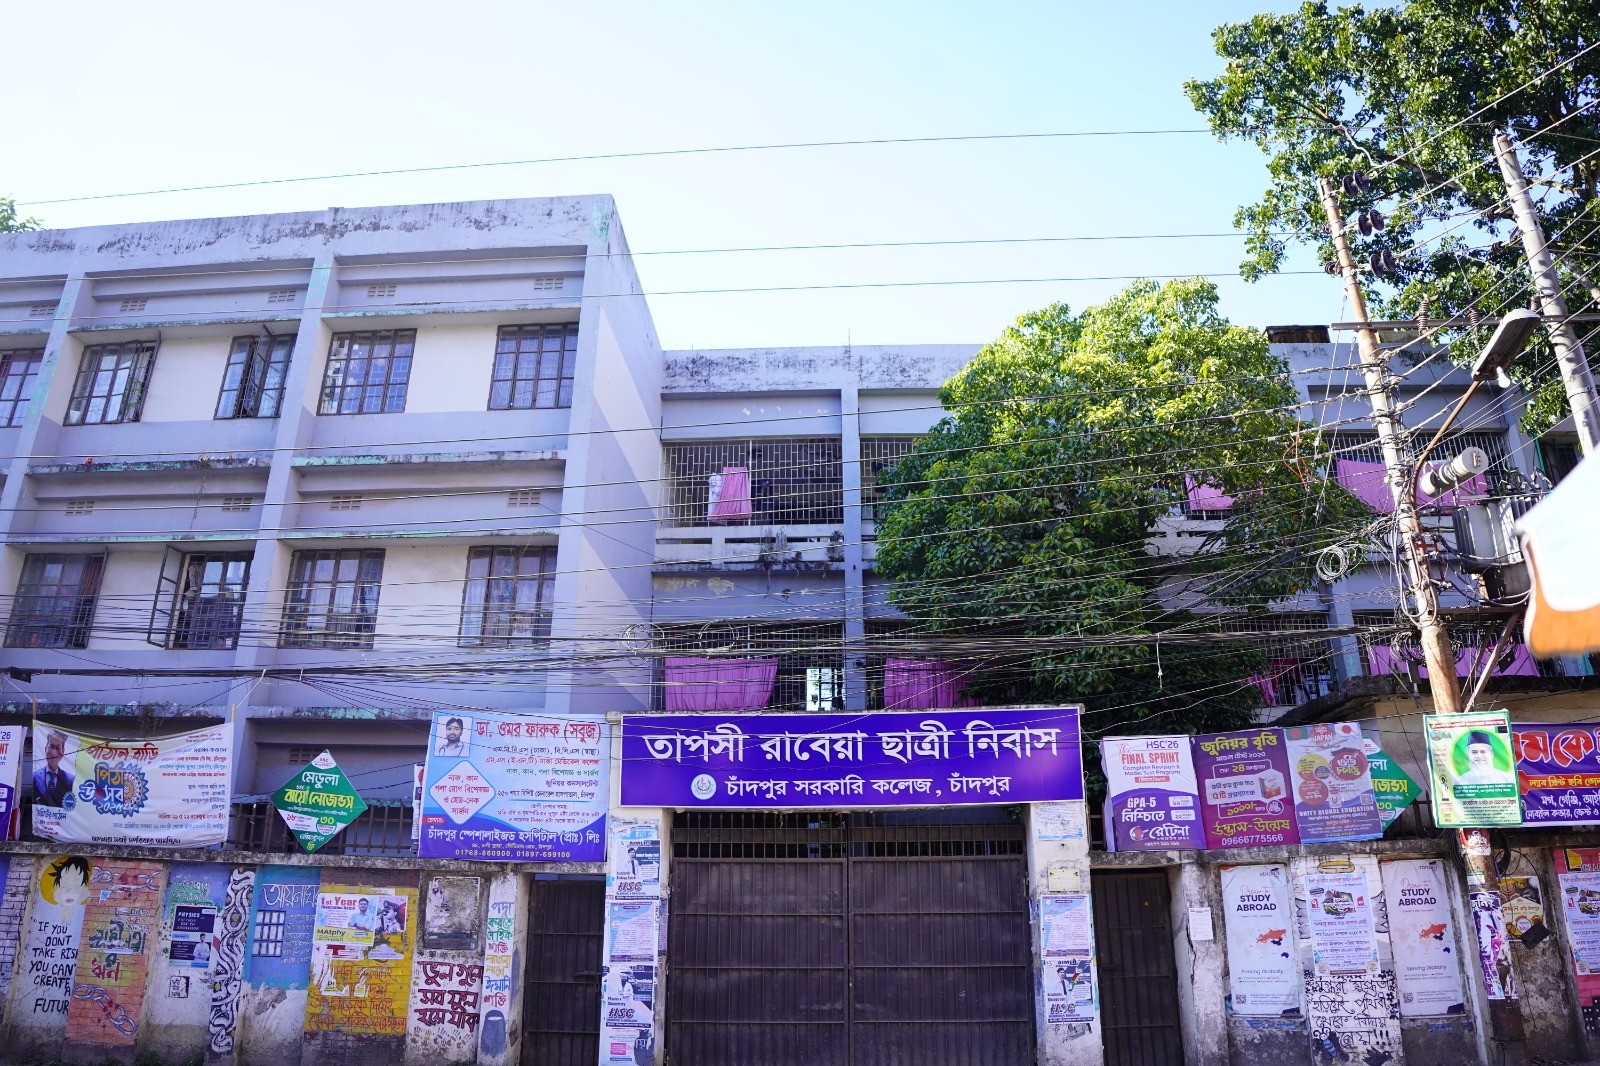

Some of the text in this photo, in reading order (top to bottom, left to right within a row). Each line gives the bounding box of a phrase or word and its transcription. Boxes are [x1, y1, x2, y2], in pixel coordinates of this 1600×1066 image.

[476, 721, 601, 744] ডা. ওমর ফারুক (সবুজ)
[642, 720, 1062, 763] তাপসী রাবেয়া ছাত্রী নিবাস
[1200, 732, 1278, 756] জুনিয়র বৃত্তি
[87, 741, 158, 764] পাঠান বাড়ি
[1122, 752, 1180, 764] FINAL SPRINT
[1232, 764, 1245, 772] ২৪
[302, 771, 340, 789] মেডুলা
[725, 775, 788, 800] চাঁদপুর
[793, 774, 866, 796] সরকারি
[948, 772, 1012, 796] চাঁদপুর
[1529, 779, 1547, 788] ল্যাব
[1568, 775, 1583, 787] ছবি
[1128, 797, 1156, 808] GPA-5
[1541, 794, 1556, 807] মগ,
[1122, 808, 1166, 822] নিশ্চিতে
[1342, 806, 1374, 814] EDUCATION
[1526, 806, 1550, 820] মোবাইল
[428, 826, 600, 845] চাঁদপুর স্পেশালাইজড হসপিটাল (প্রাঃ) লিঃ
[1149, 823, 1190, 840] রেটিনা
[1222, 834, 1284, 846] 09666775566
[618, 882, 642, 892] HSC
[1401, 888, 1430, 896] STUDY
[320, 896, 357, 906] 1st Year
[1240, 894, 1271, 902] STUDY
[1398, 897, 1436, 906] ABROAD
[1236, 904, 1276, 912] ABROAD
[52, 924, 68, 934] YOU
[45, 935, 72, 946] DONT
[32, 948, 55, 958] TAKE
[28, 960, 49, 974] YOU
[417, 961, 456, 987] ভুল
[34, 975, 70, 989] CREATE
[64, 987, 70, 996] A
[34, 998, 68, 1014] FUTUR
[418, 989, 479, 1012] সব ফুল
[608, 1008, 635, 1018] HSC
[414, 1008, 480, 1032] হয়ে যাক
